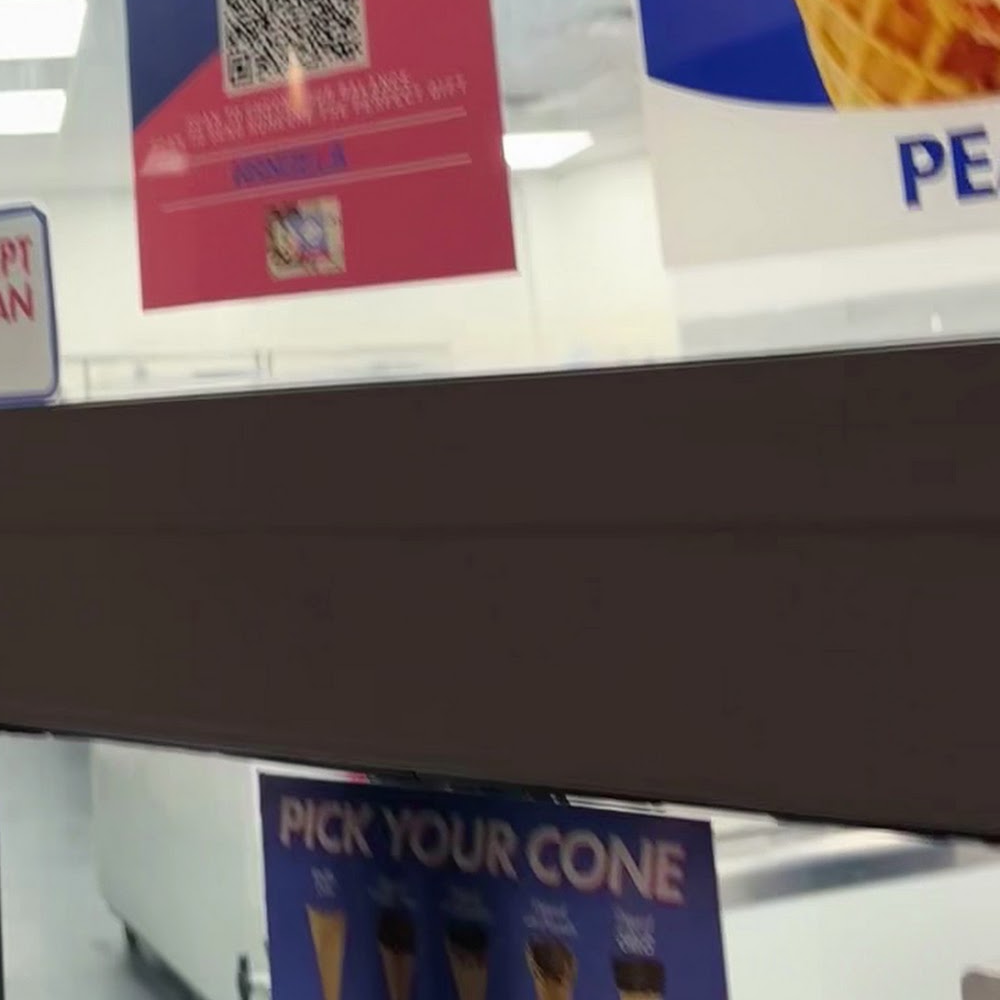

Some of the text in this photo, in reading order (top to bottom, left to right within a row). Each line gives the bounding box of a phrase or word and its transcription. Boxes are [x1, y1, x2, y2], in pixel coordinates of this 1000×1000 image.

[897, 125, 1000, 209] PE
[278, 795, 374, 858] PICK
[381, 807, 520, 882] YOUR
[526, 823, 688, 905] CONE
